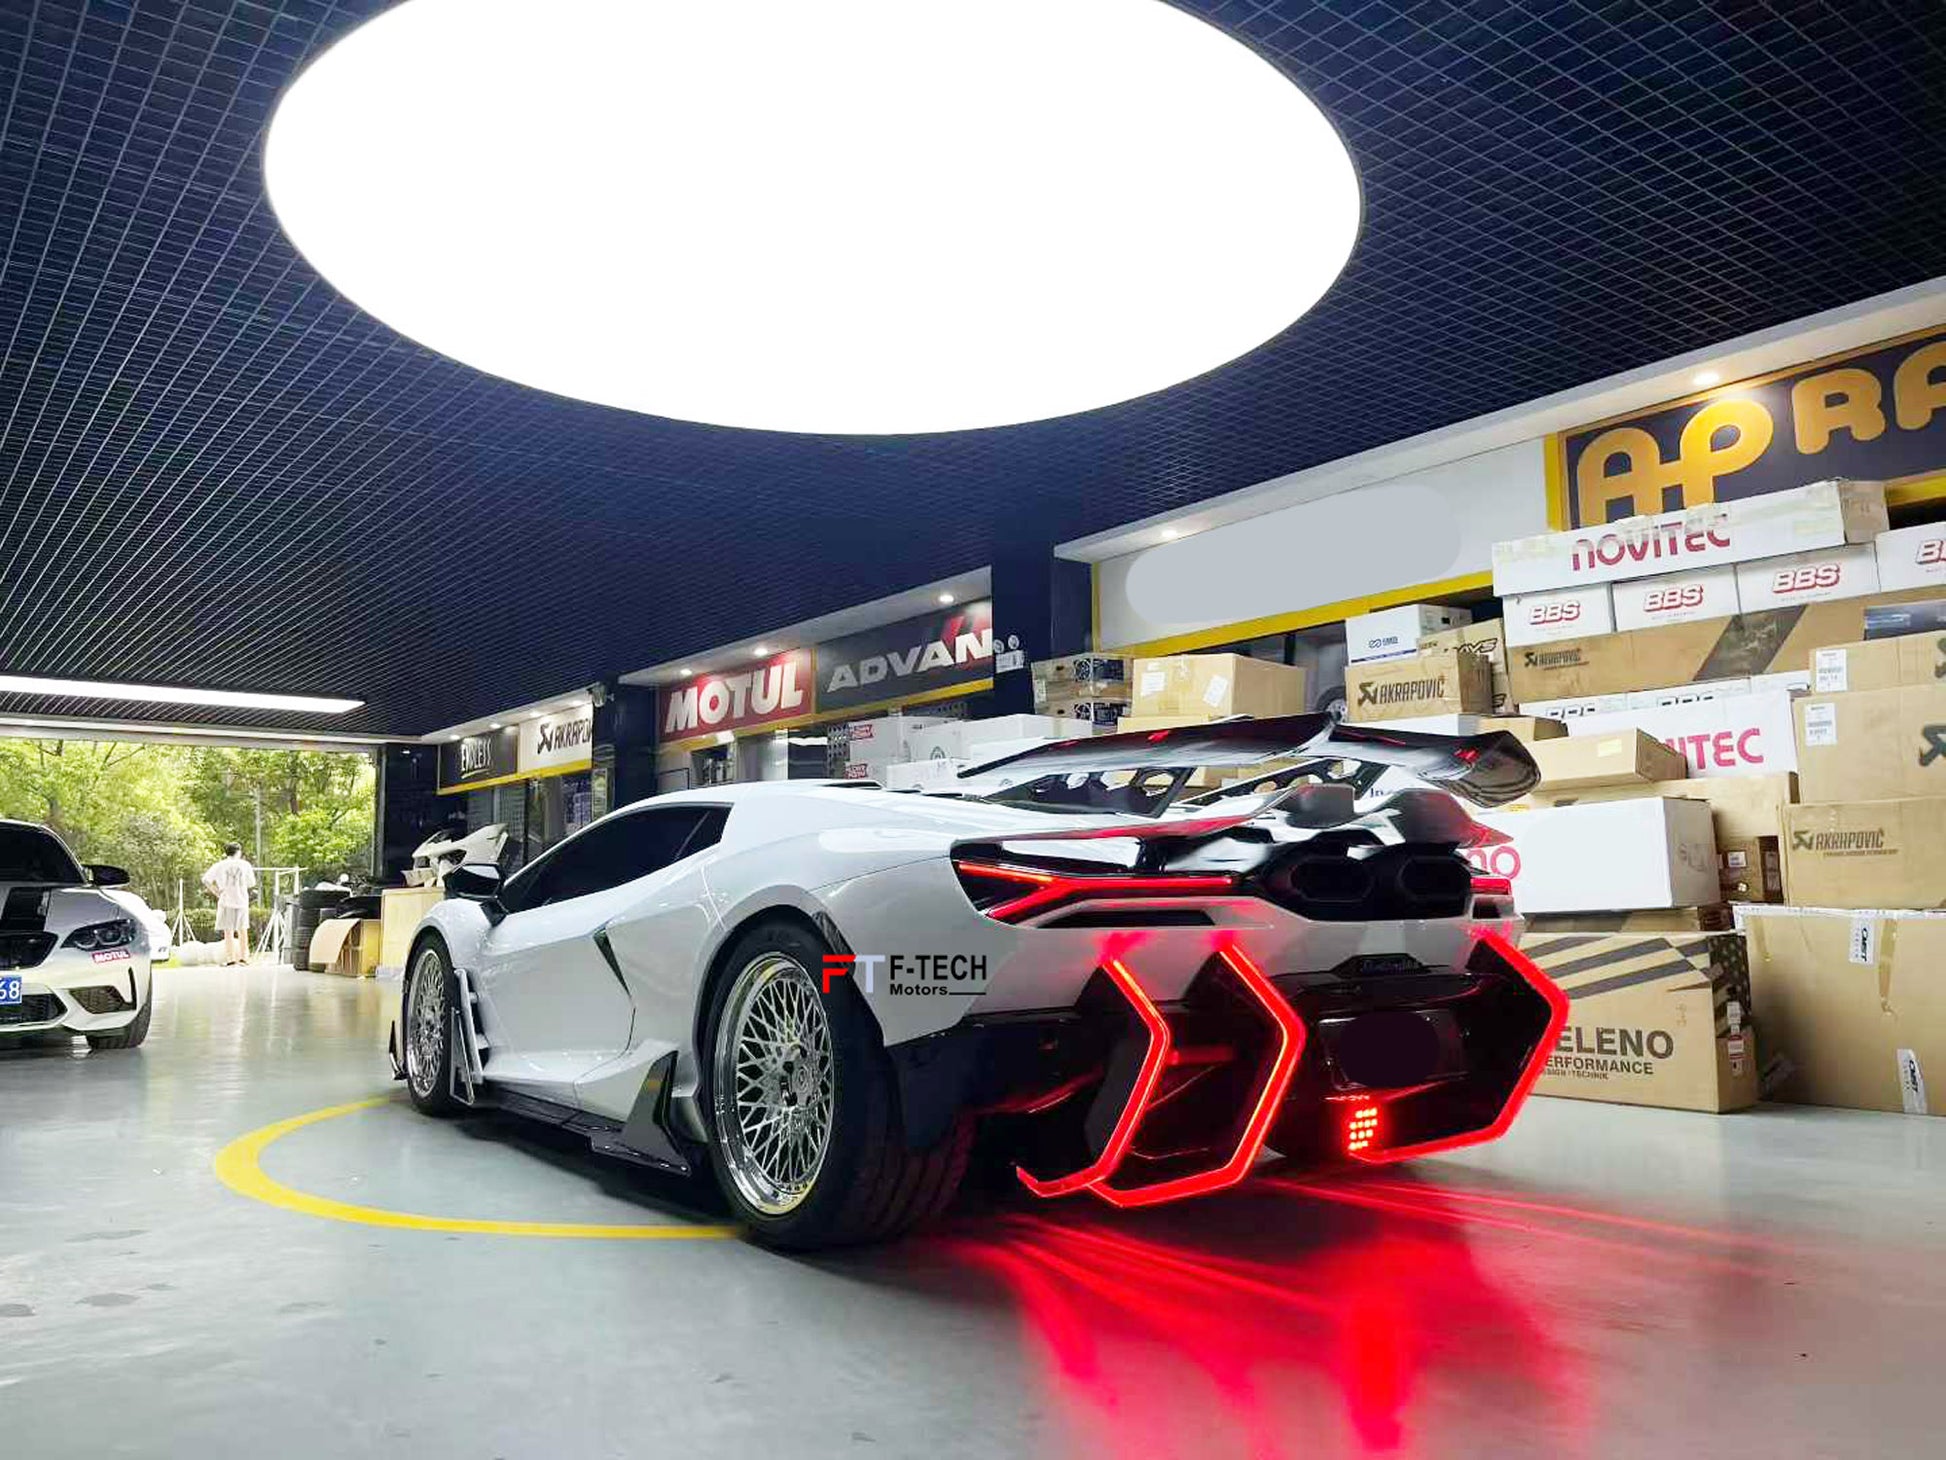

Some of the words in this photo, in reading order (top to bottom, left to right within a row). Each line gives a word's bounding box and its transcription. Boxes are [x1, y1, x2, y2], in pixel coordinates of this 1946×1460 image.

[1577, 398, 1774, 528] AP
[1772, 562, 1841, 593] BBS
[1528, 601, 1580, 625] BBS
[1643, 584, 1703, 612] BBS
[826, 628, 992, 693] ADVAN
[665, 661, 803, 733] MOTUL
[1665, 728, 1764, 769] ITEC
[94, 950, 130, 961] MOTUL
[1556, 1026, 1674, 1059] ELENO
[1546, 1056, 1654, 1075] ERFORMANCE
